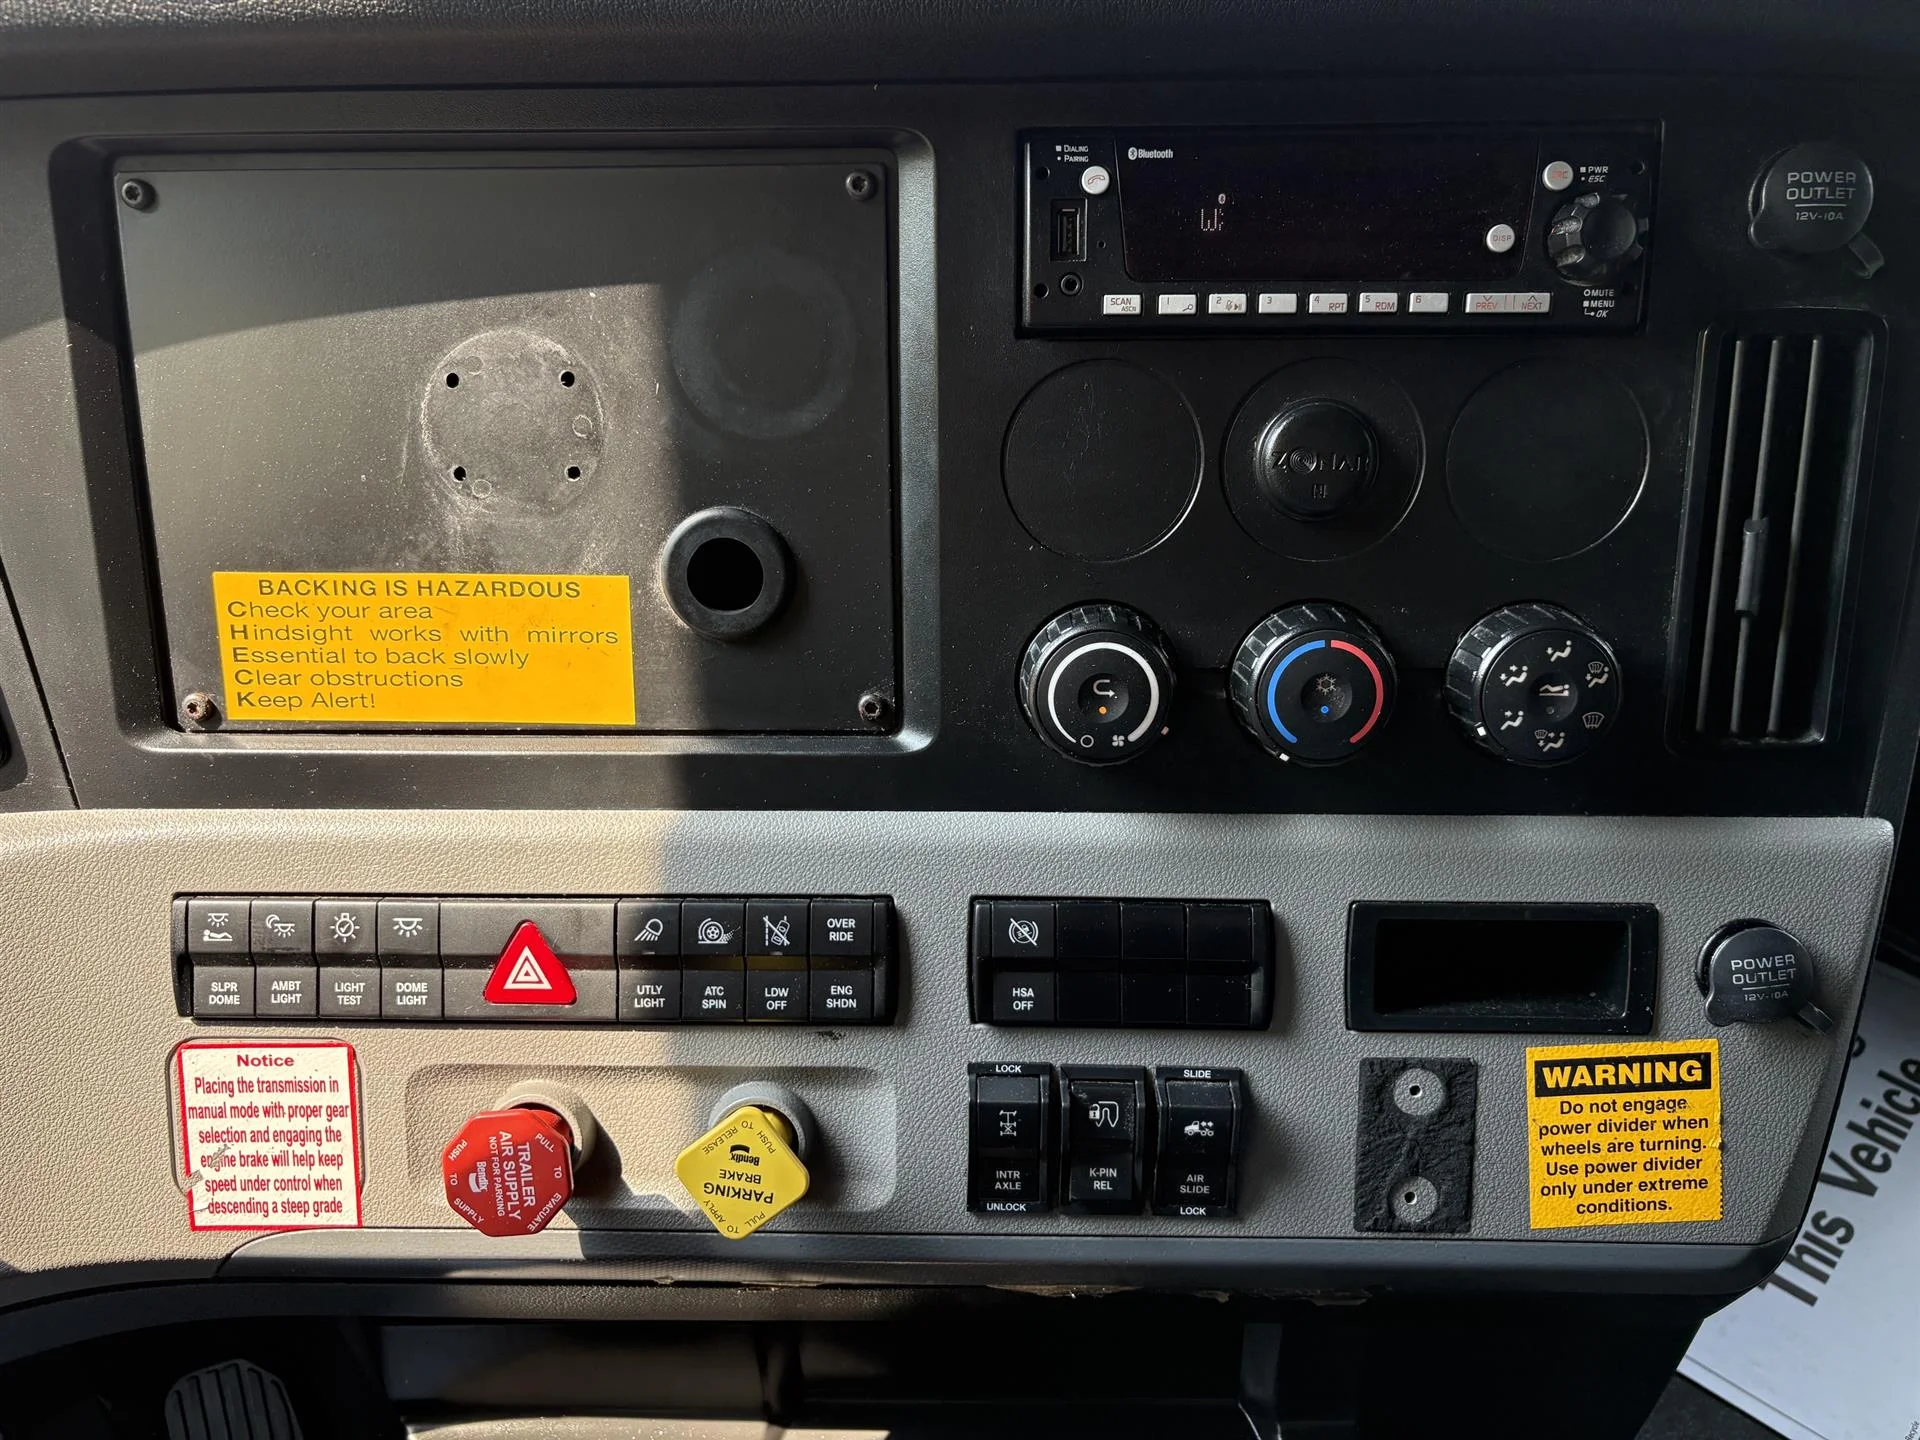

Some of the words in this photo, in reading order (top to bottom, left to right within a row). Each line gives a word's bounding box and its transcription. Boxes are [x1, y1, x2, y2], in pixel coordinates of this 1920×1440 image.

[1064, 155, 1089, 163] PAIRING
[1138, 149, 1173, 159] Bluetooth
[1787, 171, 1857, 184] POWER
[1786, 187, 1857, 200] OUTLET
[1795, 211, 1844, 221] 12V-10A
[1492, 234, 1512, 242] DISP
[1590, 289, 1615, 297] MUTE
[1110, 298, 1132, 306] SCAN
[1267, 297, 1273, 305] 3
[1314, 296, 1320, 304] 4
[1365, 295, 1371, 303] 5
[1415, 296, 1422, 304] 6
[1590, 300, 1615, 308] MENU
[1328, 303, 1345, 311] RPT
[1375, 302, 1395, 311] RDM
[1475, 302, 1499, 310] PREV
[1521, 302, 1542, 310] NEXT
[1595, 310, 1609, 318] OK
[258, 579, 377, 596] BACKING
[385, 579, 408, 596] IS
[417, 580, 581, 598] HAZARDOUS
[227, 601, 310, 618] Check
[316, 605, 370, 622] your
[379, 605, 433, 619] area
[230, 624, 352, 645] Hindsight
[369, 625, 442, 642] works
[460, 626, 509, 642] with
[527, 626, 619, 644] mirrors
[232, 647, 346, 664] Essential
[354, 649, 378, 664] to
[386, 648, 446, 664] back
[454, 649, 529, 669] slowly
[234, 669, 302, 686] Clear
[310, 670, 464, 687] obstructions
[237, 691, 303, 711] Keep
[311, 692, 376, 708] Alert!
[826, 918, 856, 929] OVER
[829, 931, 854, 942] RIDE
[1731, 954, 1796, 971] POWER
[1732, 968, 1797, 985] OUTLET
[211, 982, 238, 992] SLPR
[271, 981, 301, 991] AMBT
[335, 982, 365, 993] LIGHT
[396, 982, 428, 993] DOME
[637, 984, 663, 995] UTLY
[704, 986, 724, 996] ATC
[830, 985, 853, 995] ENG
[764, 987, 789, 997] LDW
[1012, 987, 1034, 998] HSA
[1744, 991, 1789, 1001] 12V-10A
[208, 994, 240, 1005] DOME
[271, 993, 302, 1004] LIGHT
[337, 995, 362, 1005] TEST
[396, 995, 428, 1005] LIGHT
[634, 997, 665, 1008] LIGHT
[702, 998, 727, 1009] SPIN
[826, 998, 857, 1008] SHDN
[766, 1000, 787, 1010] OFF
[1012, 1000, 1034, 1011] OFF
[236, 1054, 295, 1067] Notice
[995, 1064, 1022, 1073] LOCK
[1183, 1069, 1212, 1079] SLIDE
[1542, 1059, 1703, 1089] WARNING
[194, 1077, 235, 1098] Placing
[236, 1077, 255, 1094] the
[257, 1076, 327, 1093] transmission
[329, 1076, 339, 1093] in
[188, 1102, 227, 1120] manual
[229, 1102, 260, 1118] mode
[262, 1101, 285, 1118] with
[288, 1104, 323, 1122] proper
[325, 1104, 350, 1122] gear
[1560, 1101, 1584, 1115] Do
[1589, 1099, 1617, 1114] not
[1622, 1097, 1688, 1114] engage
[741, 1120, 754, 1130] TO
[1539, 1121, 1592, 1140] power
[1597, 1117, 1656, 1134] divider
[1662, 1115, 1709, 1131] when
[199, 1126, 247, 1144] selection
[249, 1126, 270, 1143] and
[272, 1127, 323, 1147] engaging
[325, 1125, 342, 1142] the
[702, 1126, 738, 1155] RELEASE
[489, 1136, 498, 1155] NOT
[499, 1131, 514, 1156] AIR
[534, 1133, 556, 1153] PULL
[756, 1130, 777, 1154] PUSH
[1541, 1139, 1601, 1156] wheels
[1607, 1139, 1634, 1153] are
[1640, 1136, 1707, 1154] turning.
[448, 1139, 468, 1161] PUSH
[239, 1150, 269, 1167] brake
[271, 1150, 289, 1167] will
[292, 1150, 316, 1171] help
[318, 1150, 343, 1170] keep
[491, 1156, 500, 1175] FOR
[730, 1153, 760, 1167] Bendix
[553, 1166, 562, 1179] TO
[1546, 1161, 1579, 1176] Use
[1584, 1160, 1638, 1178] power
[1643, 1156, 1703, 1172] divider
[476, 1161, 488, 1191] Bendix
[517, 1142, 536, 1208] TRAILER
[719, 1168, 762, 1184] BRAKE
[995, 1170, 1021, 1179] INTR
[1089, 1168, 1117, 1178] K-PIN
[449, 1173, 458, 1186] TO
[1186, 1174, 1204, 1184] AIR
[205, 1175, 237, 1196] speed
[240, 1174, 271, 1192] under
[273, 1174, 311, 1191] control
[313, 1174, 342, 1191] when
[503, 1161, 522, 1220] SUPPLY
[994, 1181, 1022, 1191] AXLE
[1093, 1180, 1113, 1191] REL
[1179, 1185, 1210, 1195] SLIDE
[1540, 1181, 1577, 1199] only
[1582, 1179, 1634, 1194] under
[1638, 1177, 1709, 1192] extreme
[494, 1177, 506, 1217] PARKING
[703, 1182, 774, 1204] PARKING
[208, 1197, 269, 1217] descending
[272, 1202, 279, 1213] a
[281, 1199, 310, 1217] steep
[312, 1197, 343, 1217] grade
[453, 1198, 485, 1224] SUPPLY
[527, 1192, 562, 1232] EVACUATE
[703, 1199, 726, 1224] APPLY
[986, 1202, 1026, 1212] UNLOCK
[1179, 1206, 1206, 1216] LOCK
[1576, 1199, 1673, 1215] conditions.
[744, 1211, 766, 1228] PULL
[726, 1225, 740, 1234] TO
[1757, 1209, 1855, 1307] This
